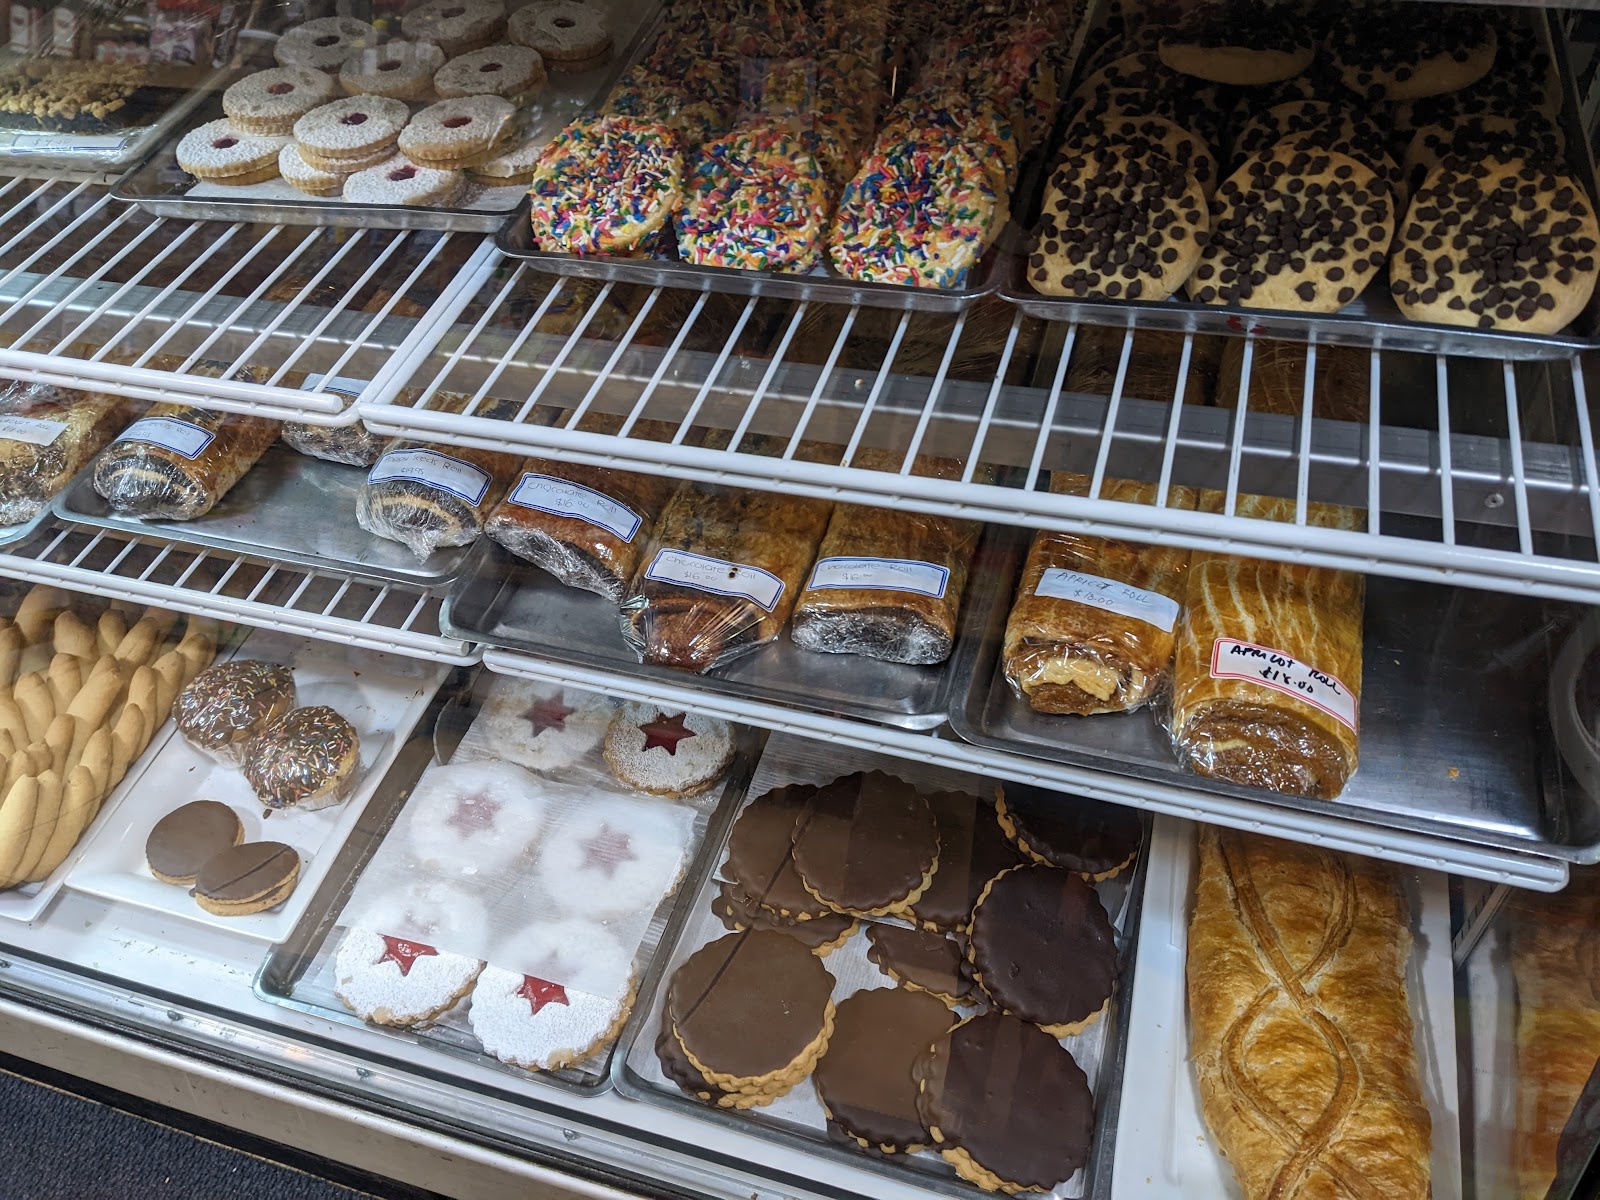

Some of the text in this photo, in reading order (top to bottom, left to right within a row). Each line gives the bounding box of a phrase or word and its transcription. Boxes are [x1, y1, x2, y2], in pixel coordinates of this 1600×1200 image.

[442, 462, 462, 474] Roll
[1056, 572, 1150, 604] APRICOT ROLL
[1259, 666, 1314, 694] $18.00
